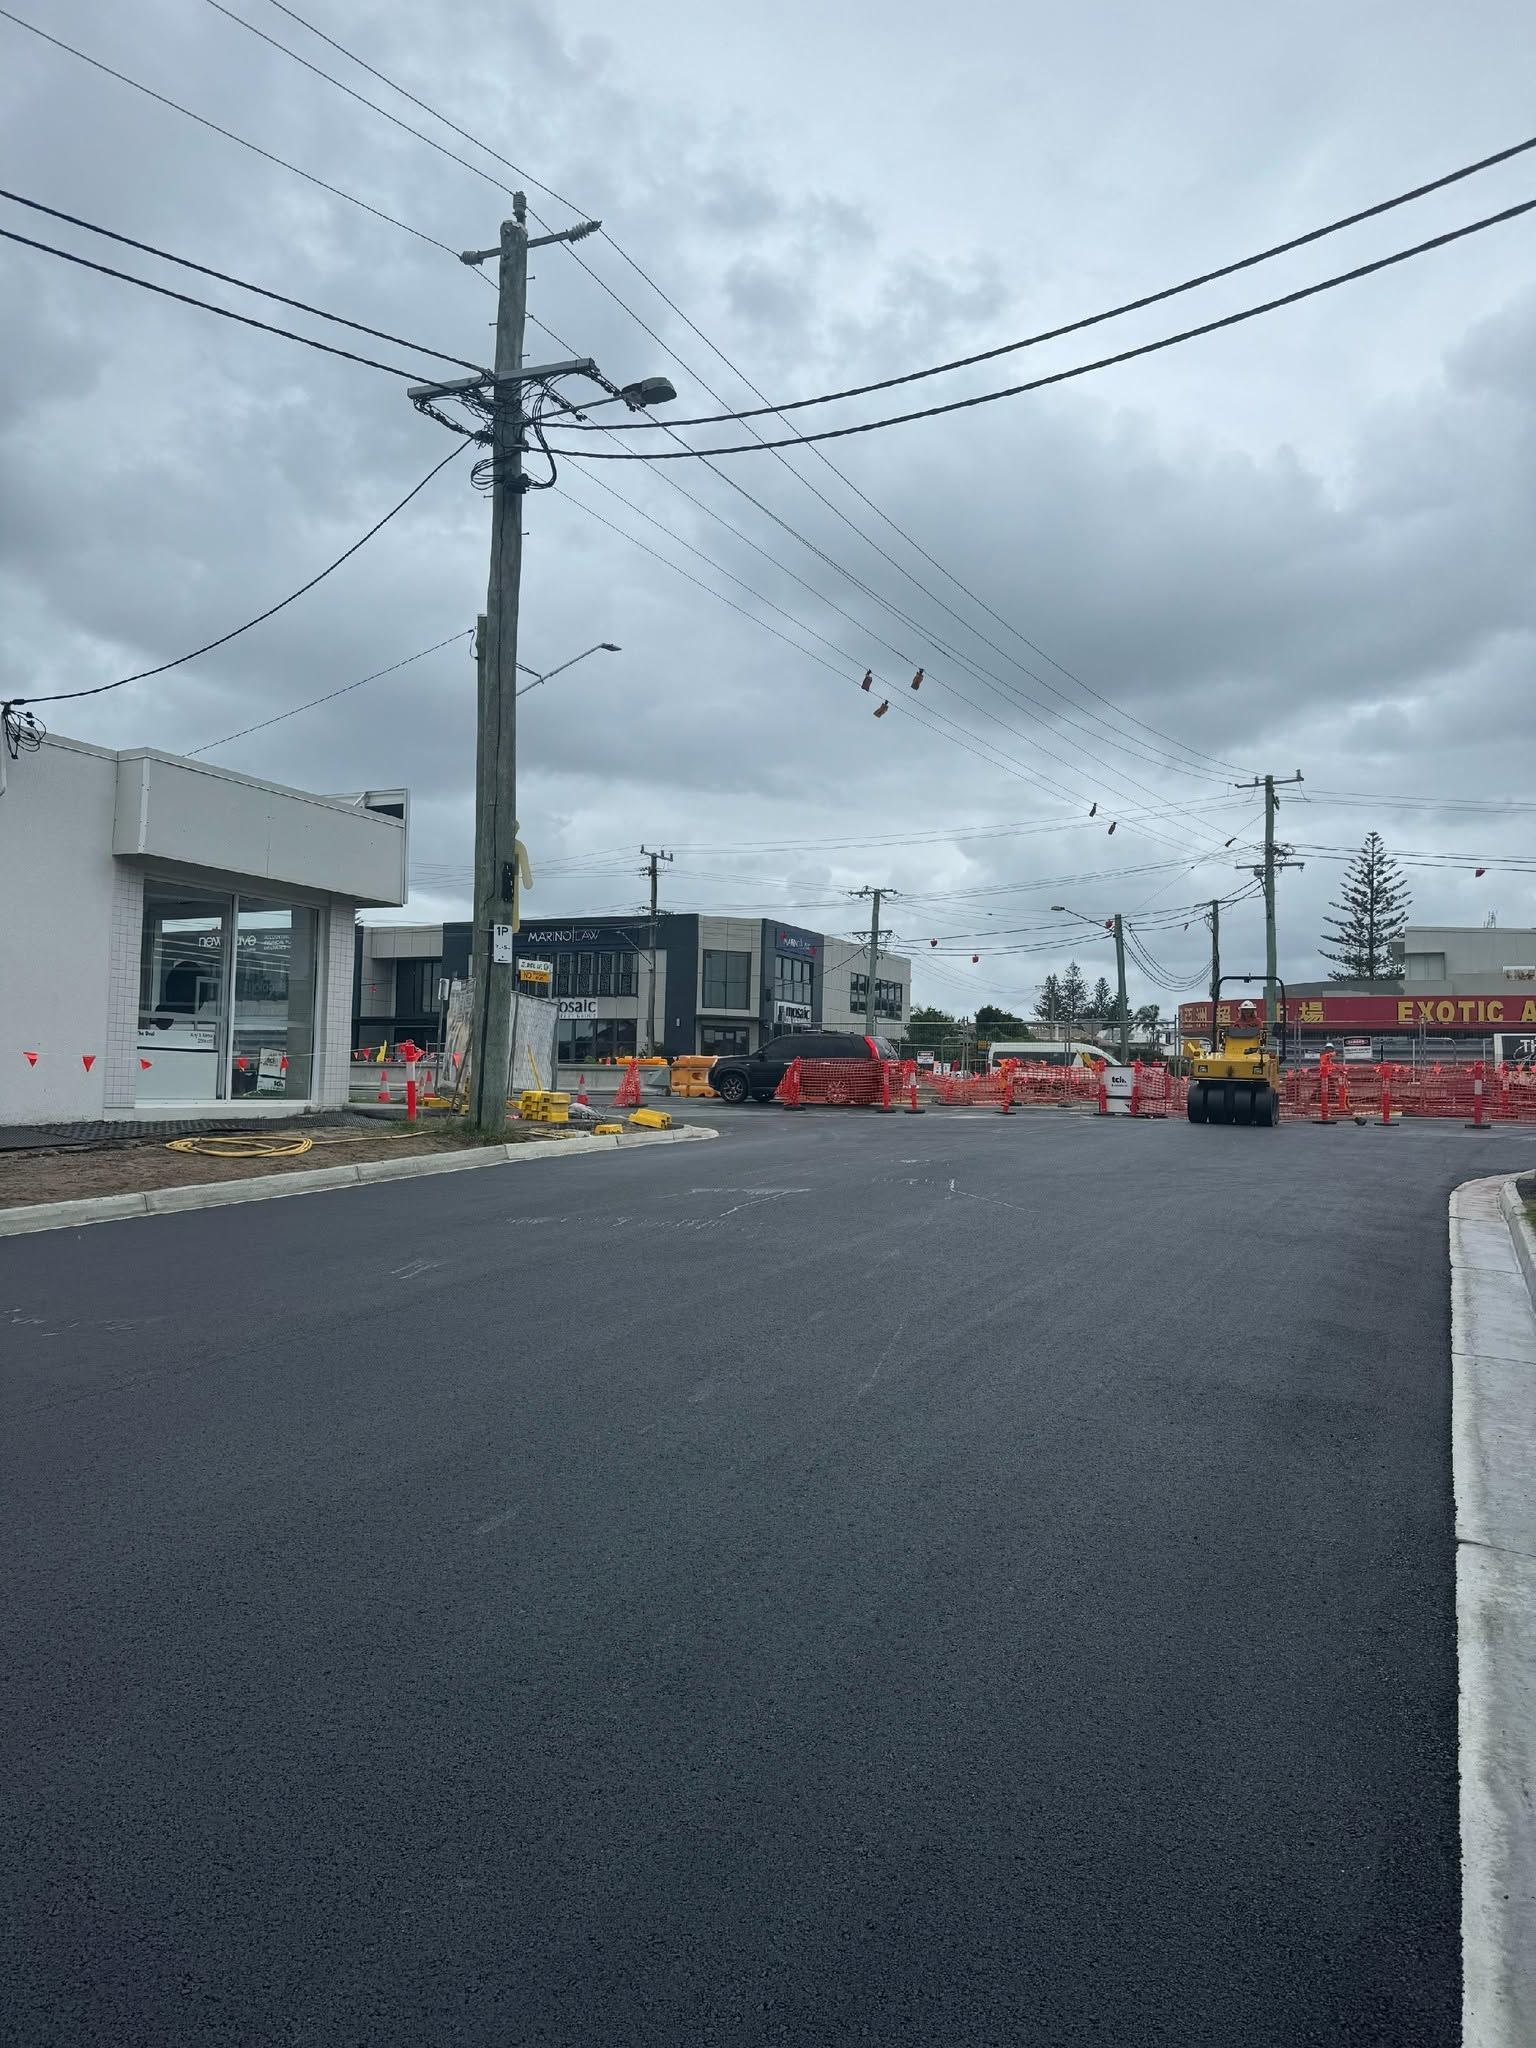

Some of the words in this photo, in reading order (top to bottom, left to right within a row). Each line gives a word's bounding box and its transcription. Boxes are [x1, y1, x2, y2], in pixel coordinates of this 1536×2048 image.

[497, 926, 509, 937] 1P
[527, 930, 572, 943] MARINO
[575, 929, 600, 941] LAW
[559, 999, 597, 1013] osaic
[1397, 1000, 1505, 1025] EXOTIC
